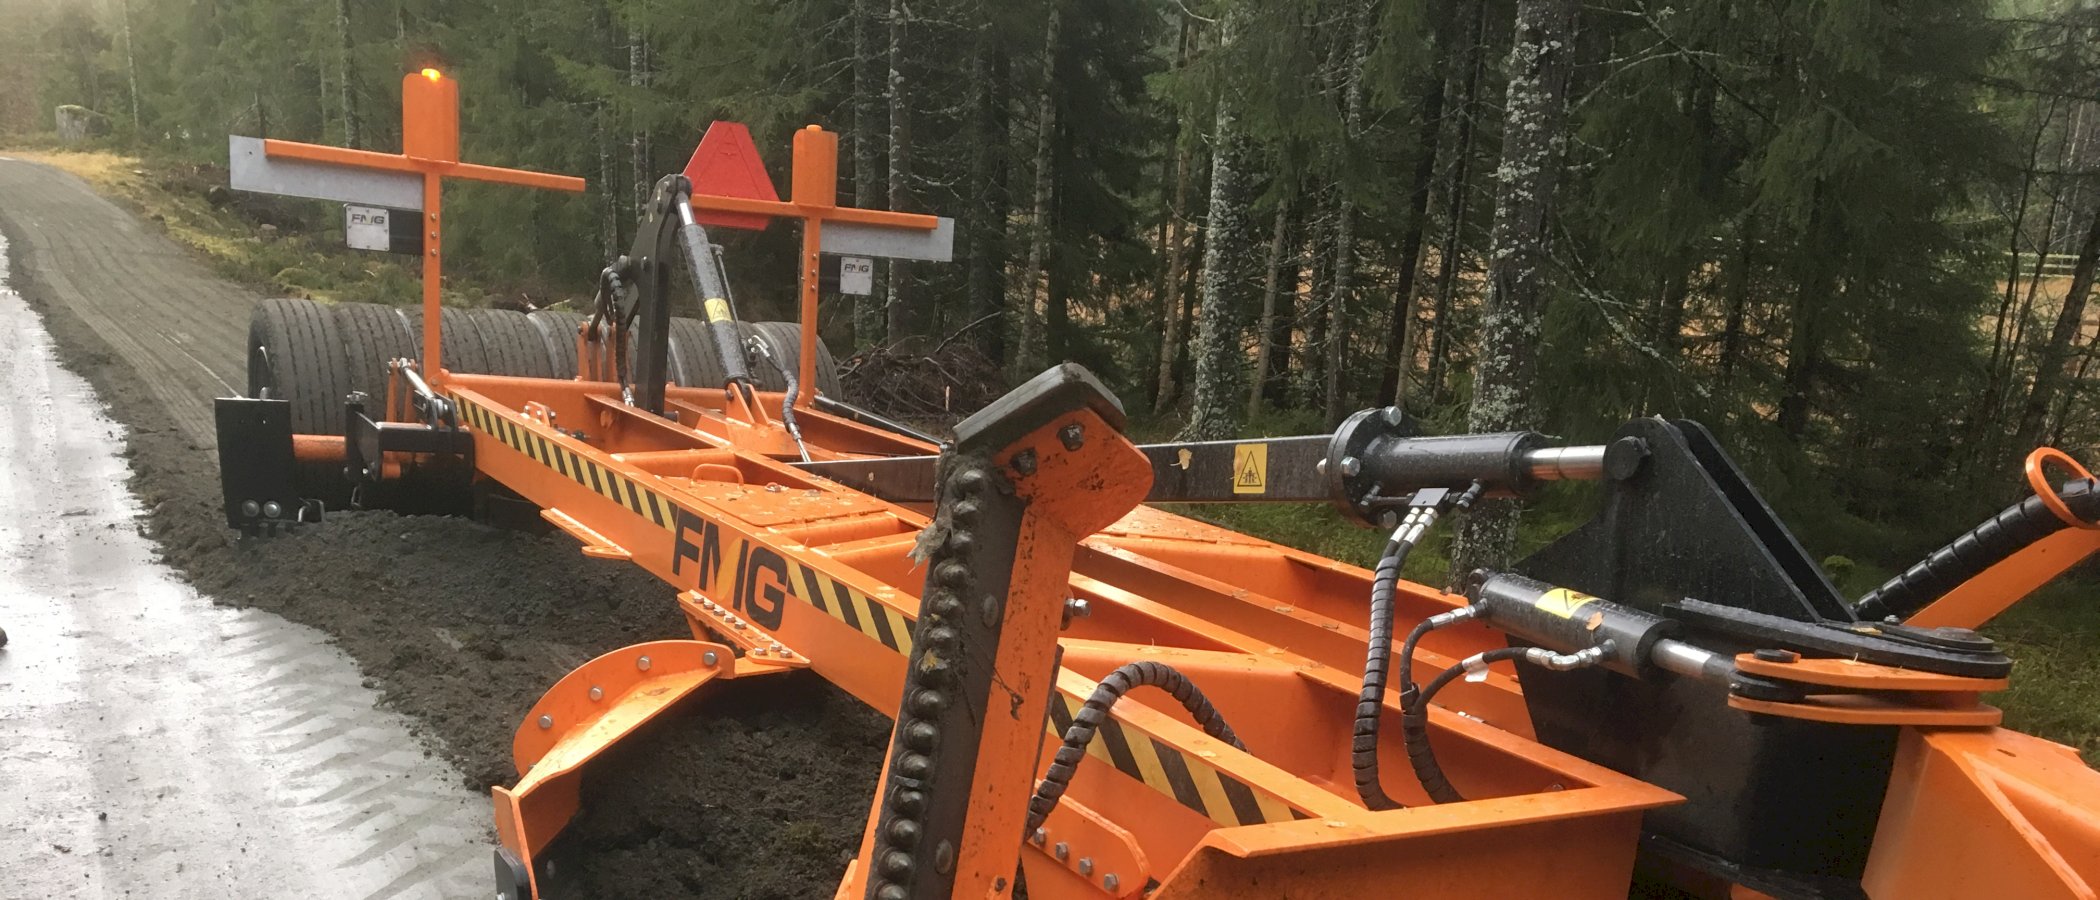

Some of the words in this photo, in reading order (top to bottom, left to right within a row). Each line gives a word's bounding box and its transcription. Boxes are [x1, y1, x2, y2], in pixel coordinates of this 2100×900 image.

[352, 214, 385, 225] FMG
[845, 264, 869, 272] FMG
[672, 506, 788, 631] FMG
